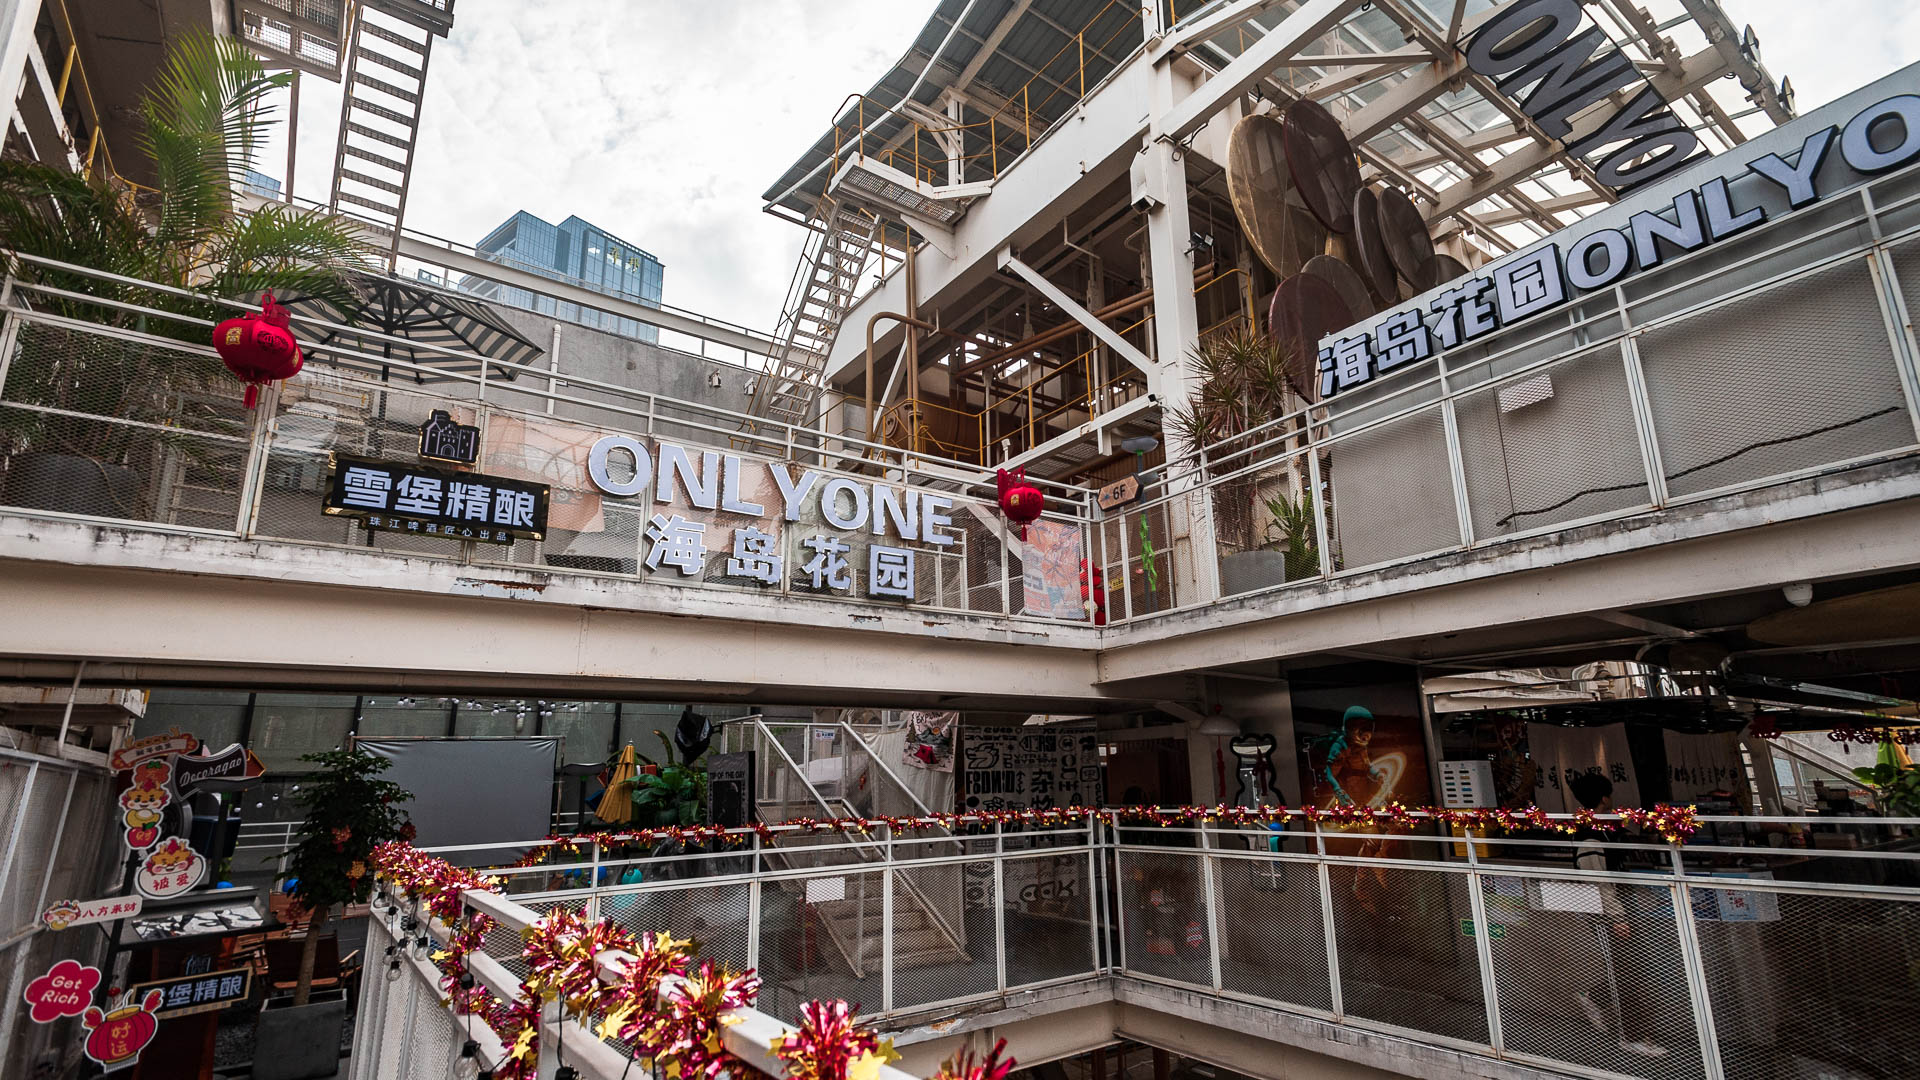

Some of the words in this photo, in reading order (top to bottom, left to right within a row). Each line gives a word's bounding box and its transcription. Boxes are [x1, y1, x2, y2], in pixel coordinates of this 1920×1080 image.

[1466, 0, 1711, 200] ONLYO
[1319, 242, 1569, 397] 海岛花园
[343, 466, 536, 529] 雪堡精酿
[588, 435, 954, 545] ONLYONE
[1113, 484, 1126, 500] 6F
[369, 516, 508, 542] 珠江啤酒匠心出品
[645, 513, 915, 600] 海岛花园
[41, 989, 79, 1005] Rich
[51, 975, 83, 990] Get
[111, 1022, 131, 1057] 好运
